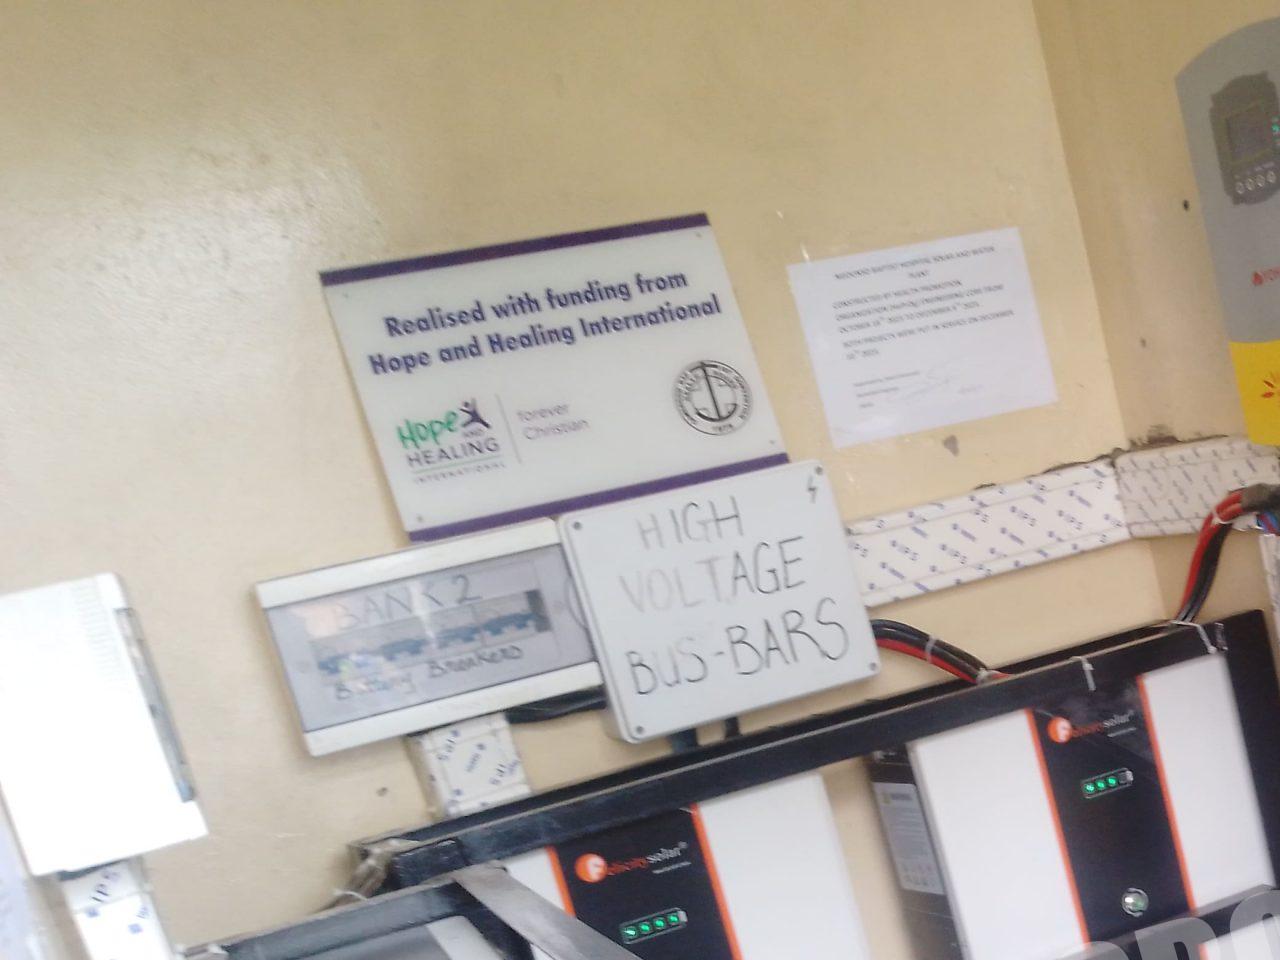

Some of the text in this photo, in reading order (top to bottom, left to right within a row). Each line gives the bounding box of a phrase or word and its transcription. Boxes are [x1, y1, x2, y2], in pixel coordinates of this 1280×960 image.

[384, 270, 688, 338] Realised with funding from
[368, 293, 722, 376] Hope and Healing International
[396, 410, 459, 450] Hope
[406, 437, 500, 468] HEALING
[640, 496, 742, 549] HIGH
[452, 574, 484, 603] 2
[619, 536, 807, 615] VOLTAGE
[626, 598, 850, 697] BUS-BARS
